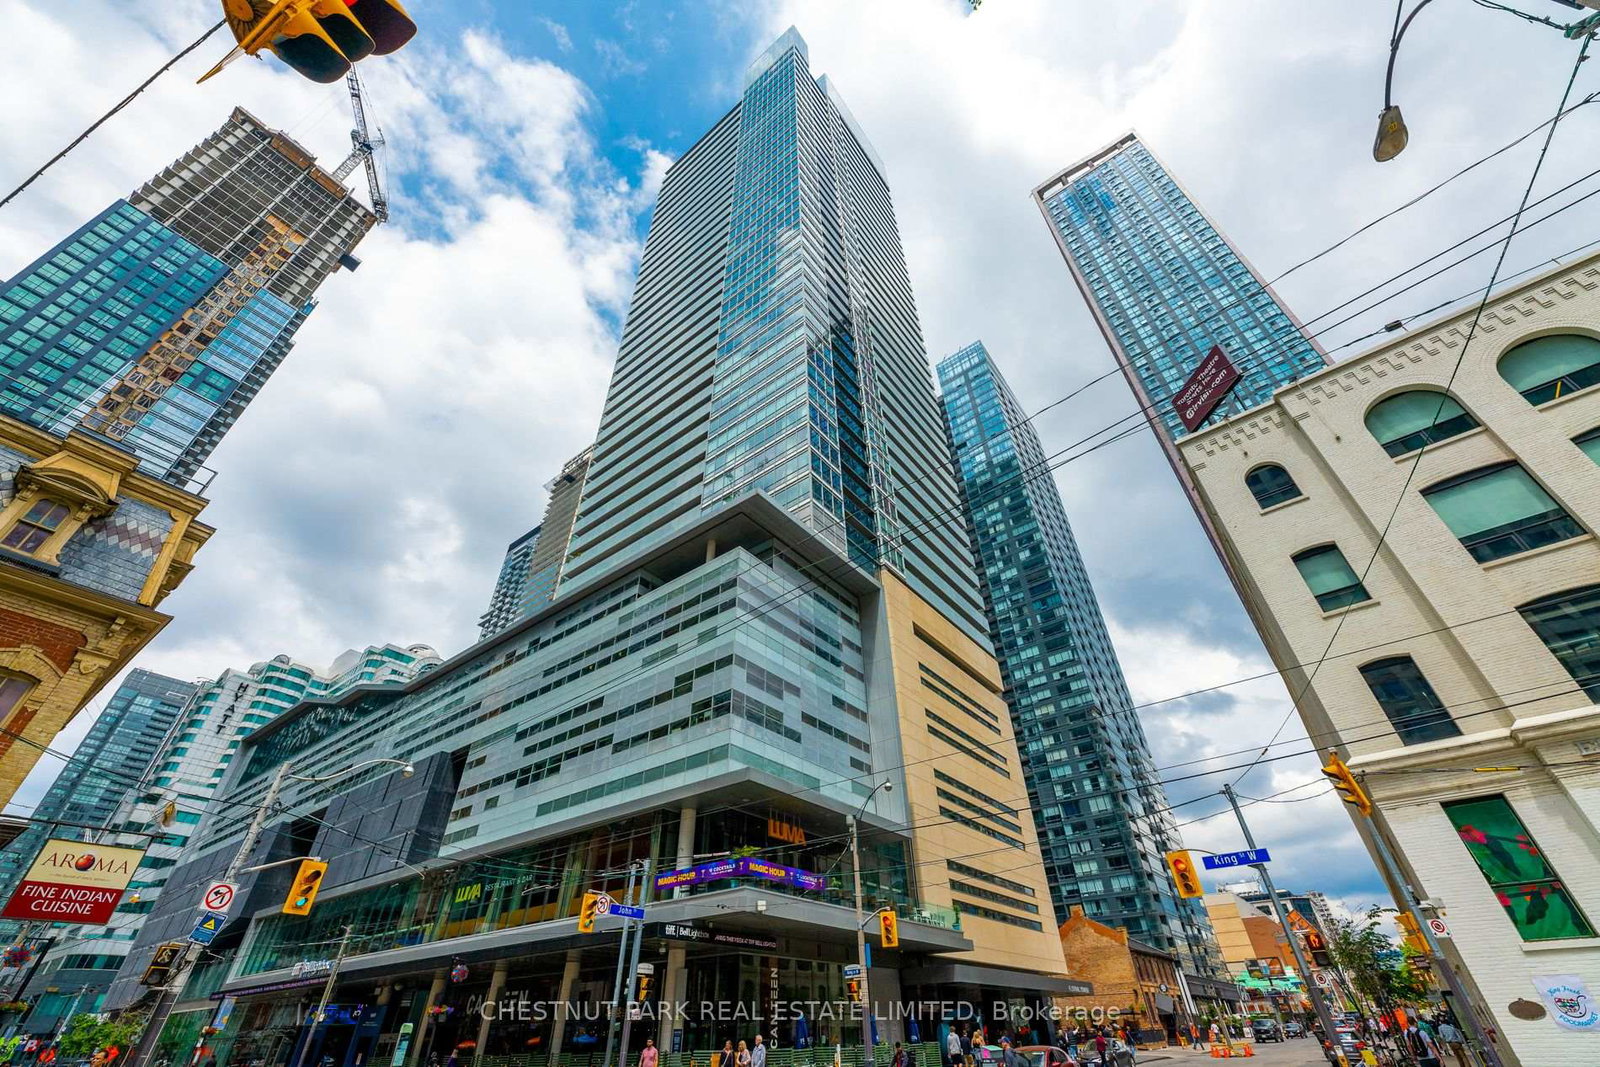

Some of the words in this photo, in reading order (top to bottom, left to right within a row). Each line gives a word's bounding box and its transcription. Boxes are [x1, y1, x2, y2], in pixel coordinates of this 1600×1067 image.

[216, 682, 249, 734] HYATT
[768, 818, 807, 846] LUMA
[41, 852, 129, 874] AROMA
[1213, 855, 1239, 865] King
[1247, 850, 1257, 860] W
[749, 862, 768, 873] MAGIC
[769, 867, 786, 877] HOUR
[658, 876, 678, 886] MAGIC
[677, 872, 696, 882] HOUR
[22, 885, 58, 899] FINE
[60, 888, 116, 903] INDIAN
[30, 899, 94, 914] CUISINE
[618, 906, 633, 915] John
[466, 990, 529, 1015] CAEEN
[769, 967, 779, 1049] CANTEEN
